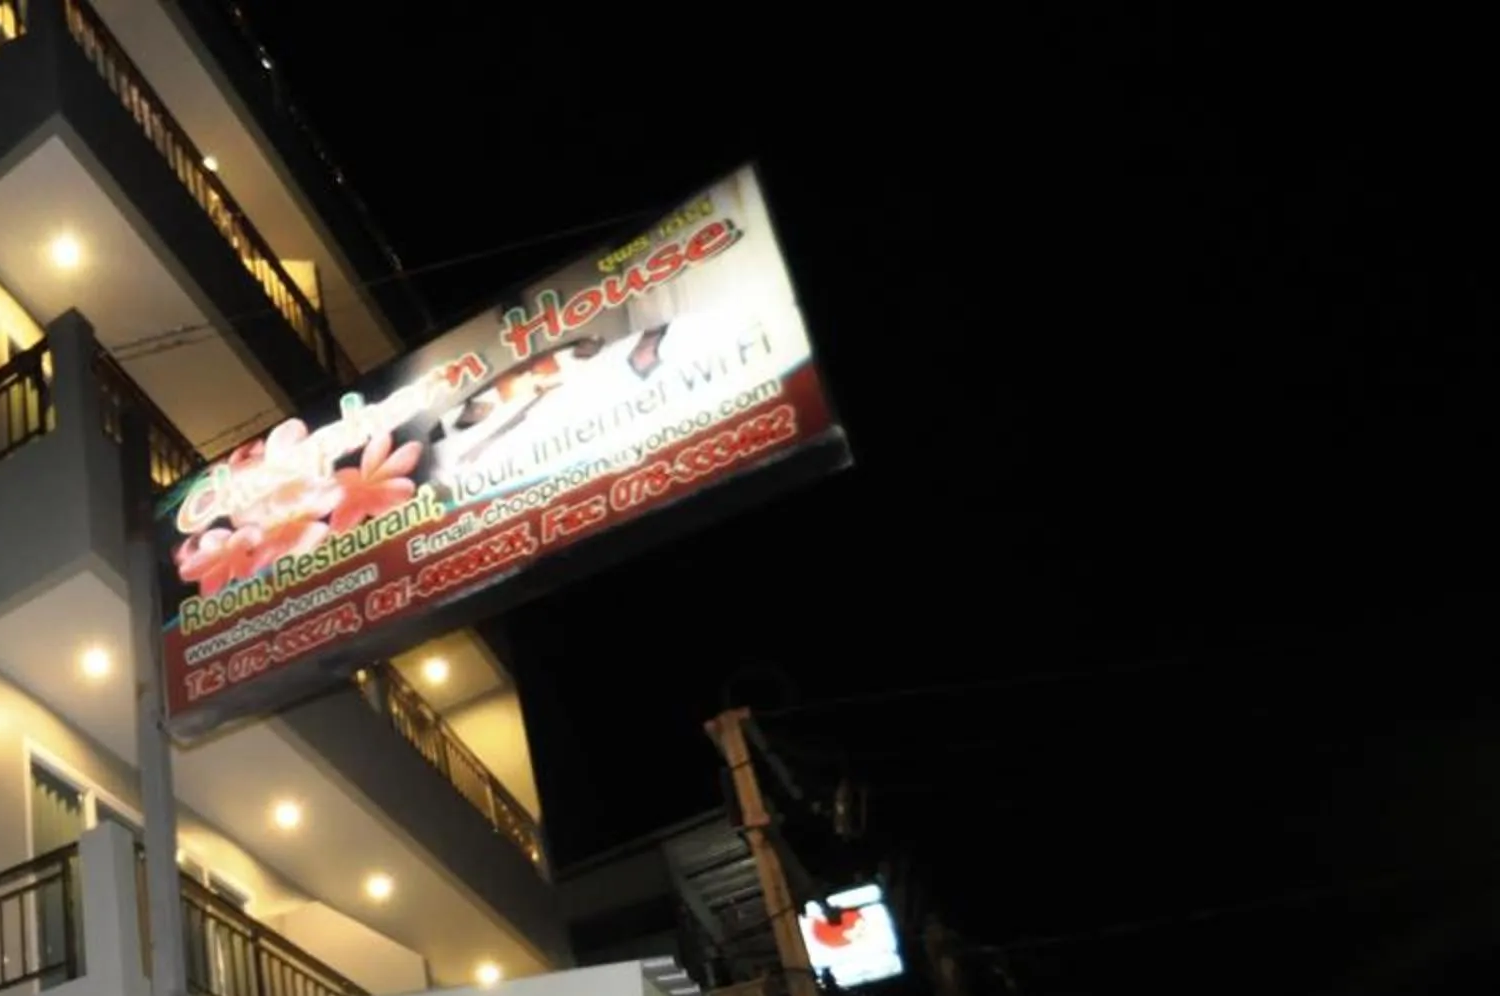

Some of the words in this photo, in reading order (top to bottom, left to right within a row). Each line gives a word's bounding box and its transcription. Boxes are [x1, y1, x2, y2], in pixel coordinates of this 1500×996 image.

[501, 218, 743, 360] House
[180, 575, 273, 634] Room,
[273, 482, 445, 591] Restaurant,
[184, 563, 379, 665] www.choophorn.com
